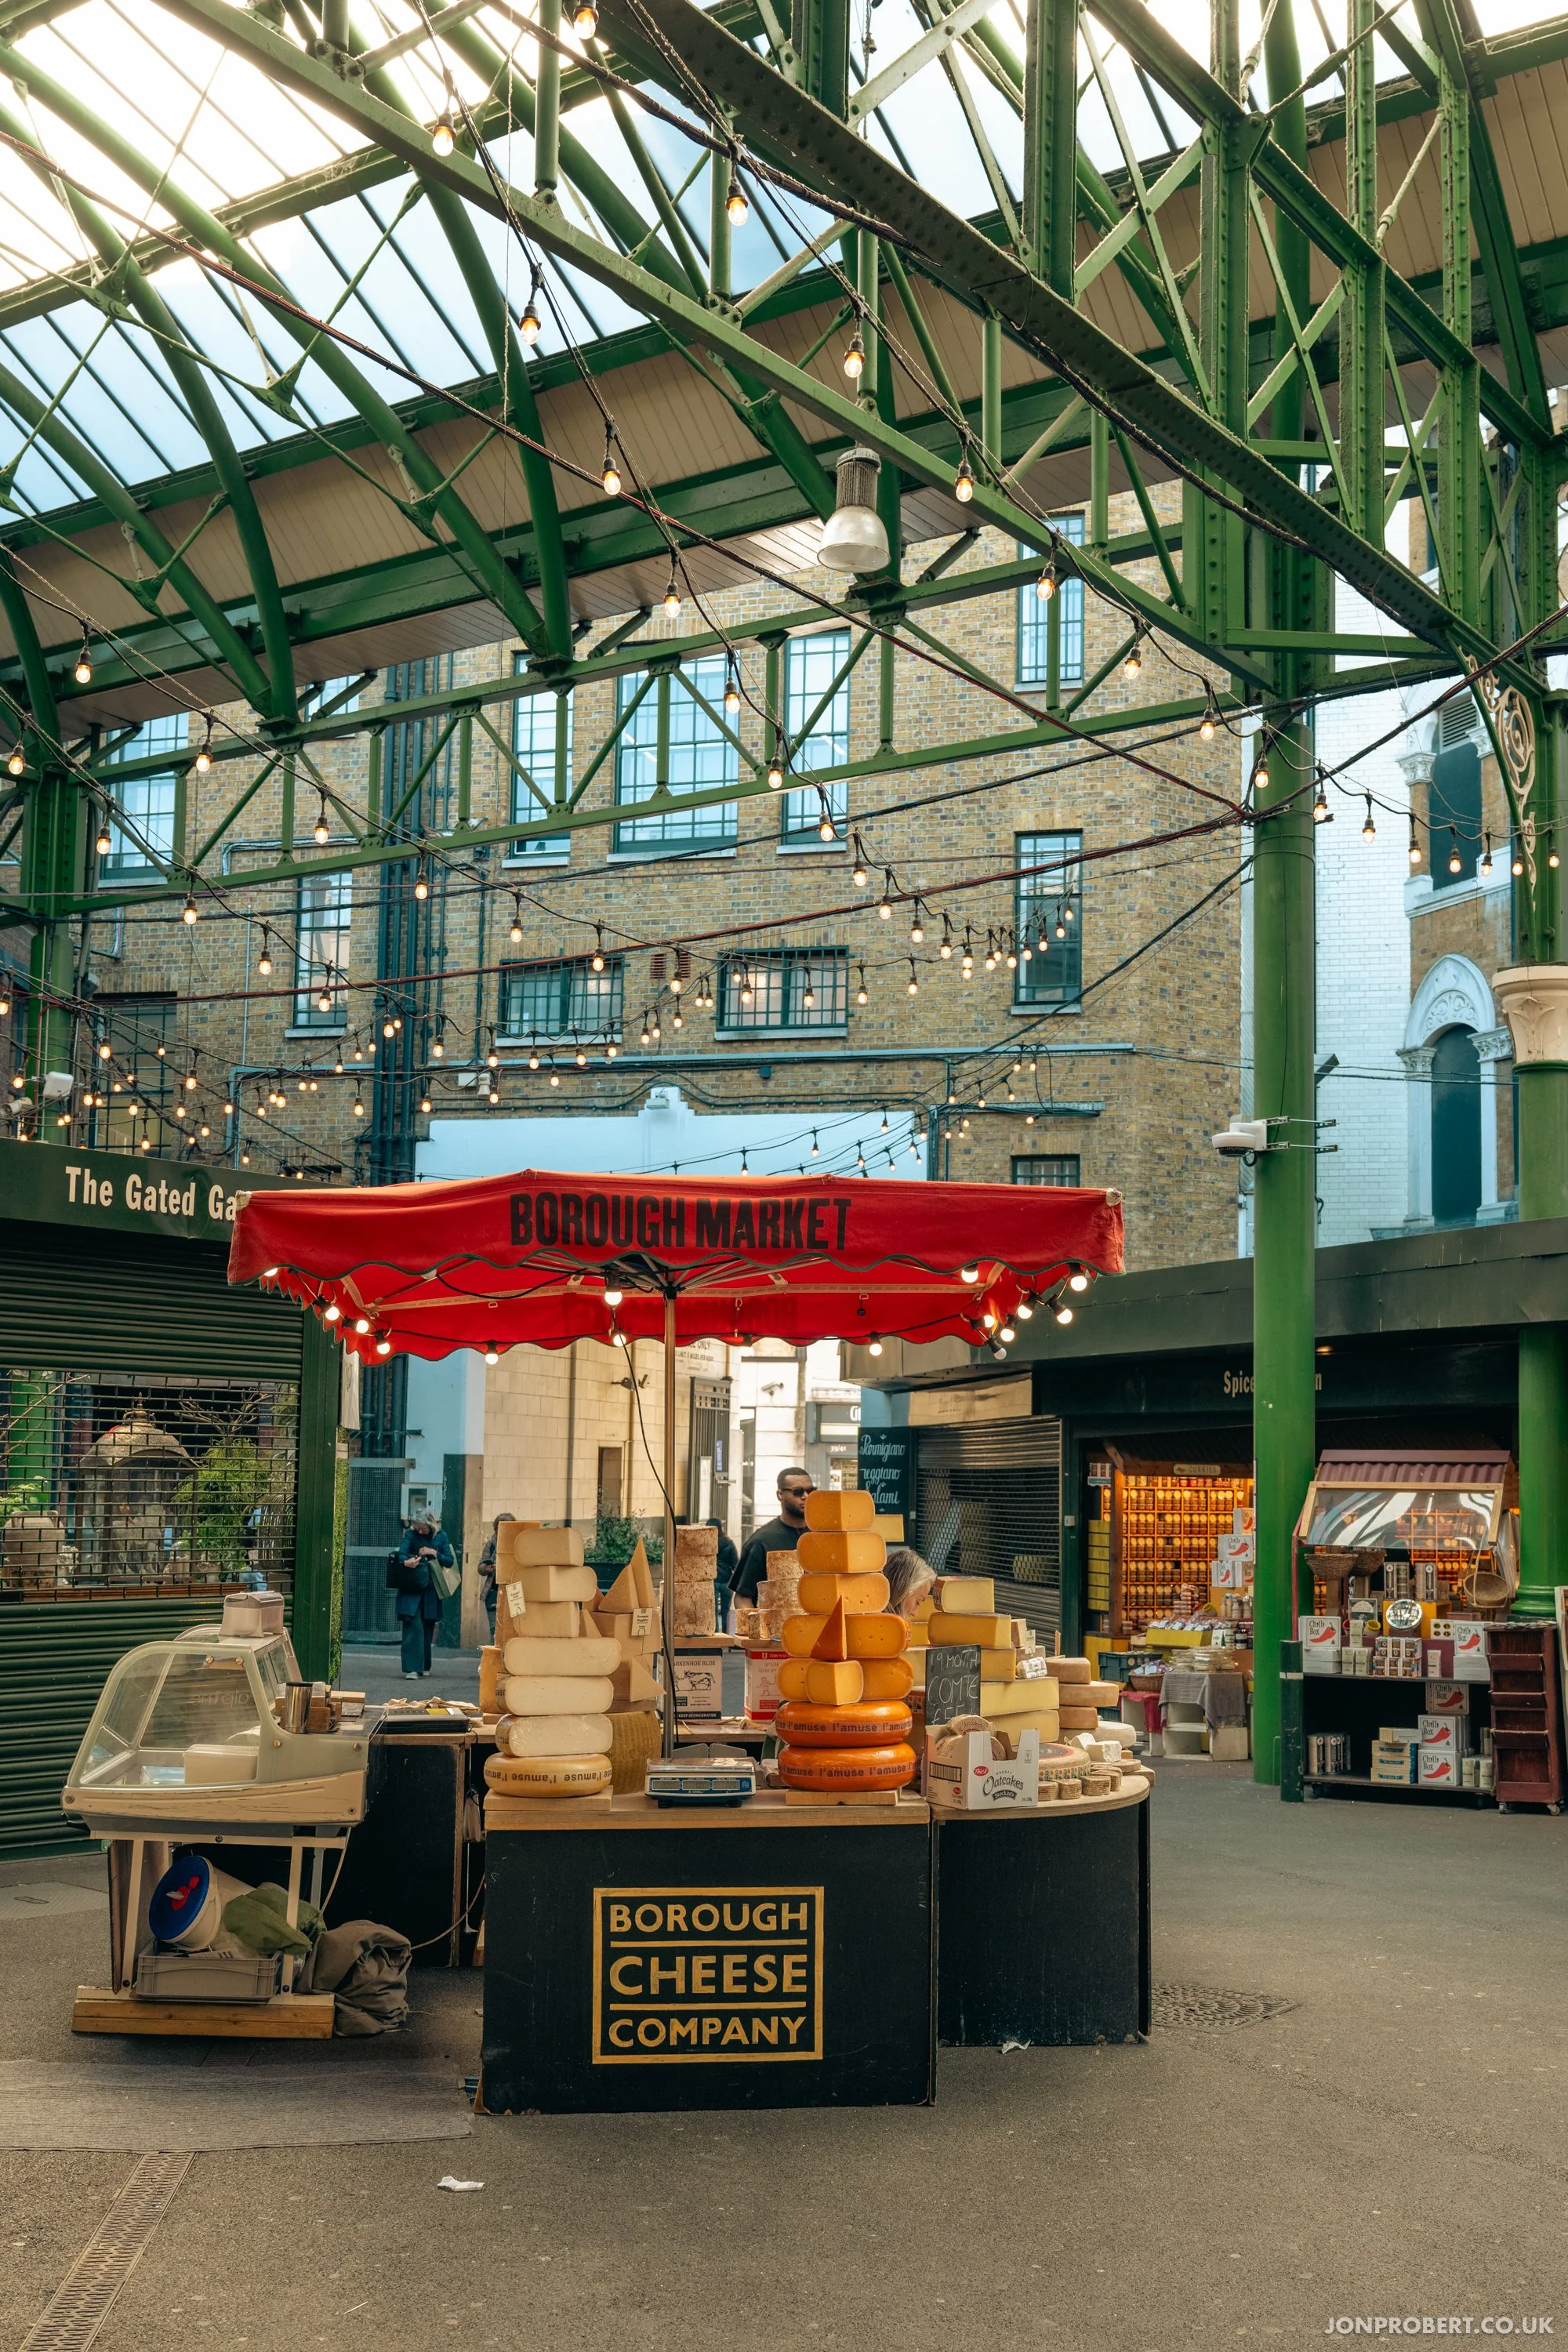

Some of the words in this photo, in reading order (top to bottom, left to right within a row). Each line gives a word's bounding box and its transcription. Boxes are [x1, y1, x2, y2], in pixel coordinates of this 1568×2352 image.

[65, 1166, 114, 1207] The
[125, 1174, 196, 1217] Gated
[510, 1192, 686, 1249] BOROUGH
[695, 1196, 853, 1250] MARKET
[1223, 1370, 1255, 1398] Spice
[859, 1434, 906, 1462] Parmigiano
[859, 1468, 902, 1485] reggiano
[931, 1653, 943, 1671] 19
[946, 1649, 978, 1669] MONTH
[927, 1675, 979, 1707] COMTE
[1436, 1691, 1447, 1700] Box
[788, 1721, 826, 1732] l'amuse
[833, 1723, 877, 1732] l'amuse
[1423, 1727, 1434, 1736] Box
[784, 1764, 813, 1777] l'amuse
[819, 1767, 864, 1777] l'amuse
[869, 1765, 906, 1776] l'amuse
[1423, 1762, 1434, 1770] Box
[511, 1773, 557, 1784] l'amuse
[564, 1771, 601, 1781] l'amuse
[983, 1774, 1024, 1795] Oatcakes
[609, 1902, 808, 1933] BOROUGH
[609, 1954, 808, 1996] CHEESE
[608, 2016, 807, 2048] COMPANY
